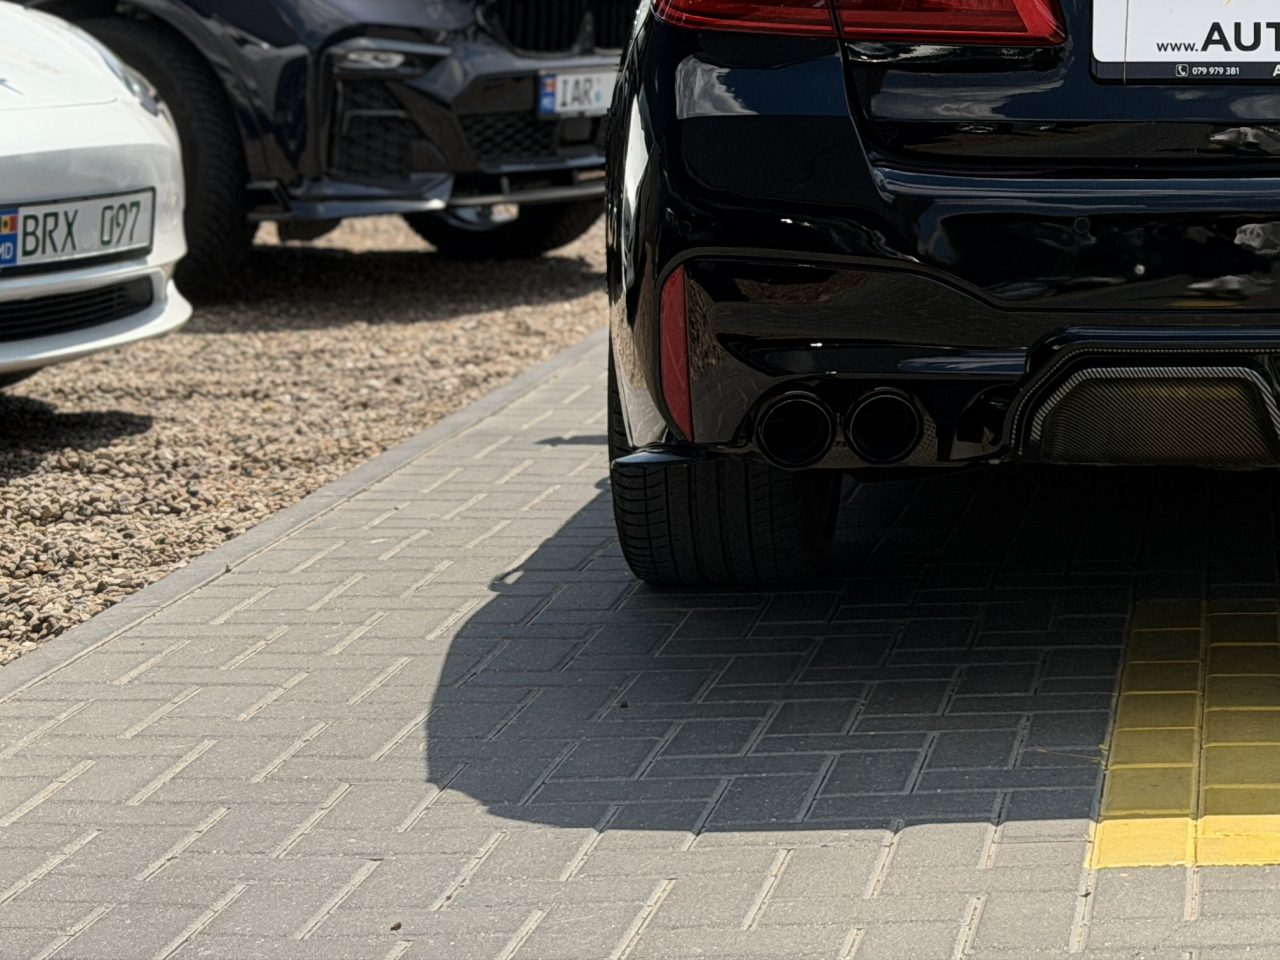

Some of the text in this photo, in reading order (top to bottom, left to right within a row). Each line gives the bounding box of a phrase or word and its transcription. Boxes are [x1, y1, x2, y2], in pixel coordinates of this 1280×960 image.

[1192, 66, 1240, 75] 079 979 381
[22, 200, 141, 258] BRX 097
